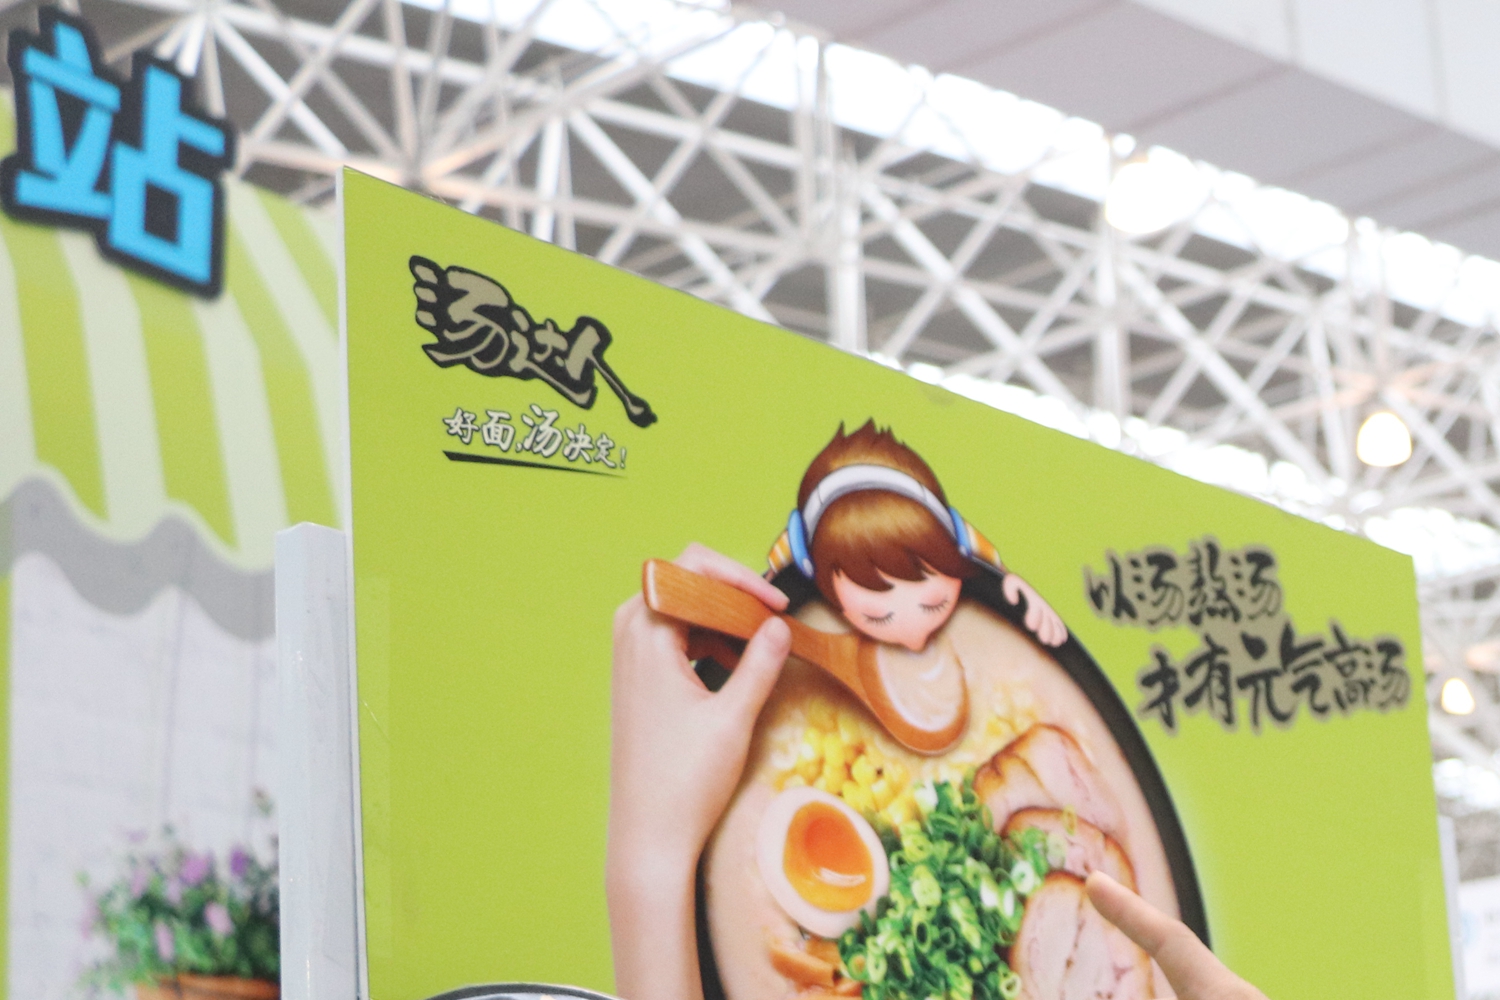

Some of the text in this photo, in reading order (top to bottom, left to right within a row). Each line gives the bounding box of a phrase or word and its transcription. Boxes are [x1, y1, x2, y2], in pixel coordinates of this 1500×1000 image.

[8, 12, 232, 292] 站
[409, 255, 657, 428] 汤达人
[1139, 620, 1411, 735] 才有元气高汤
